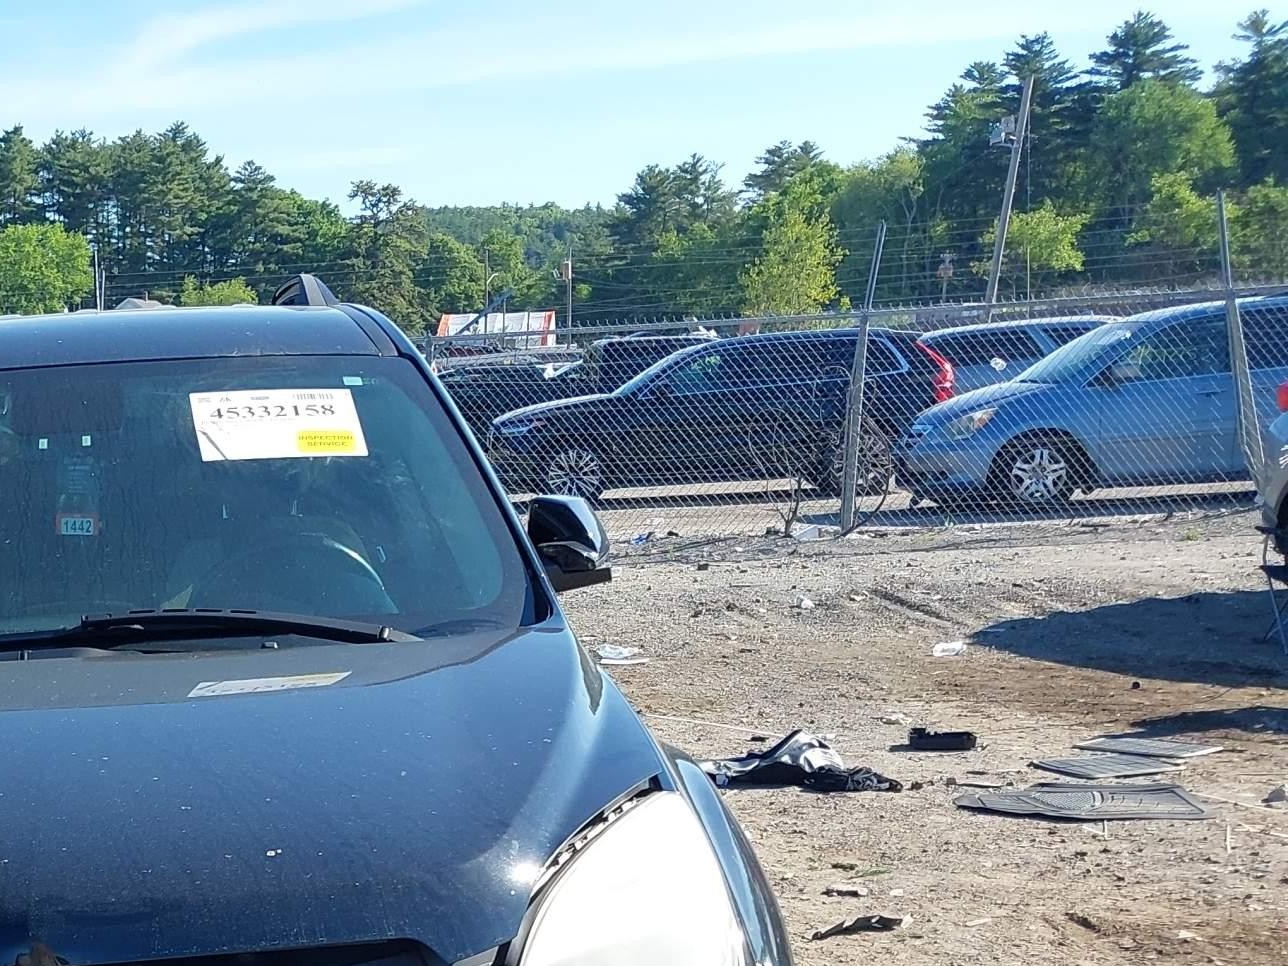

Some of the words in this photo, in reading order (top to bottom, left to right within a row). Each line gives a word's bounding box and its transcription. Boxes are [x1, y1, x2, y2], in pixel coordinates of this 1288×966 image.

[209, 403, 336, 419] 45332158
[298, 434, 354, 442] INSPECTION
[63, 519, 92, 534] 1442
